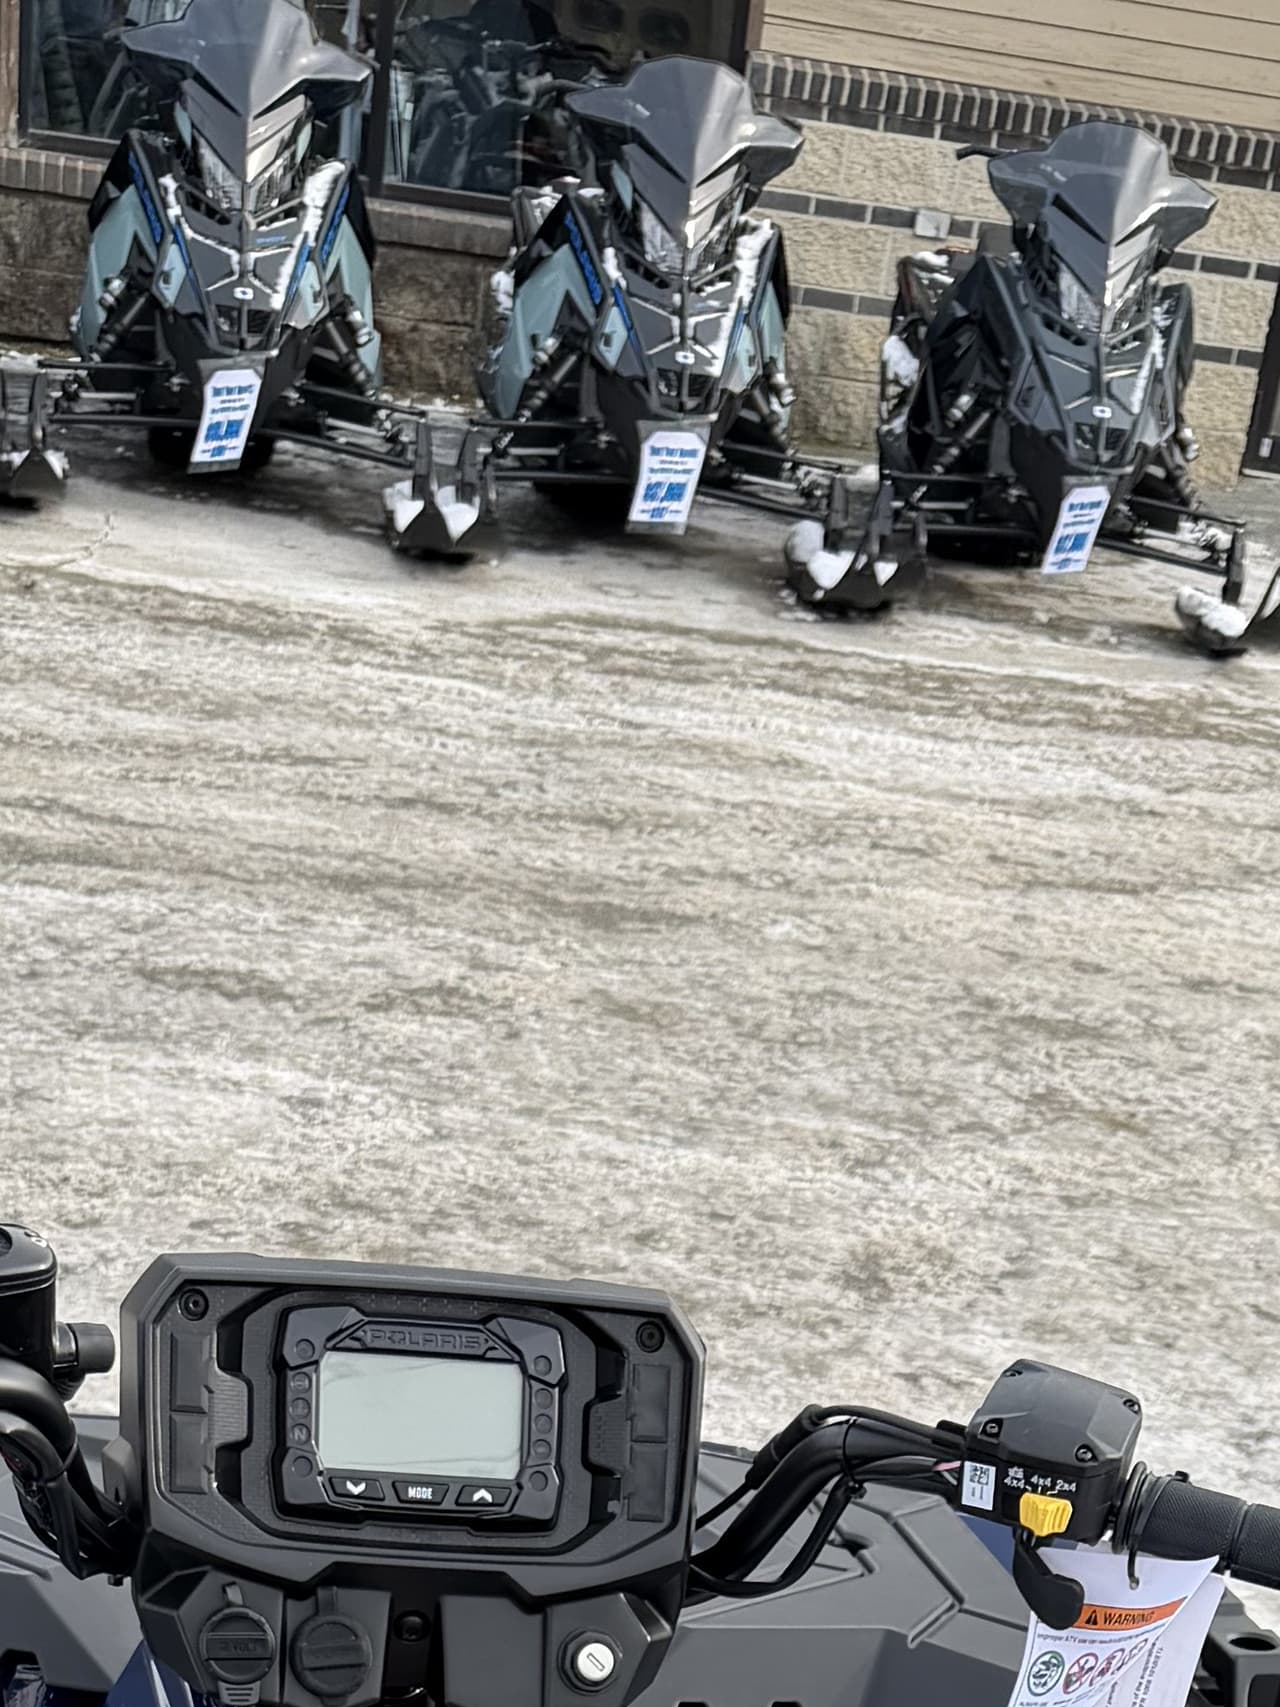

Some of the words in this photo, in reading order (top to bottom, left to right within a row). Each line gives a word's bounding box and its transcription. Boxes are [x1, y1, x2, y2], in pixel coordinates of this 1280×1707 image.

[370, 1329, 484, 1350] POLARIS
[1030, 1474, 1052, 1487] 4x4
[1055, 1479, 1077, 1493] 2x4
[407, 1485, 433, 1500] MODE
[1102, 1611, 1156, 1626] WARNING
